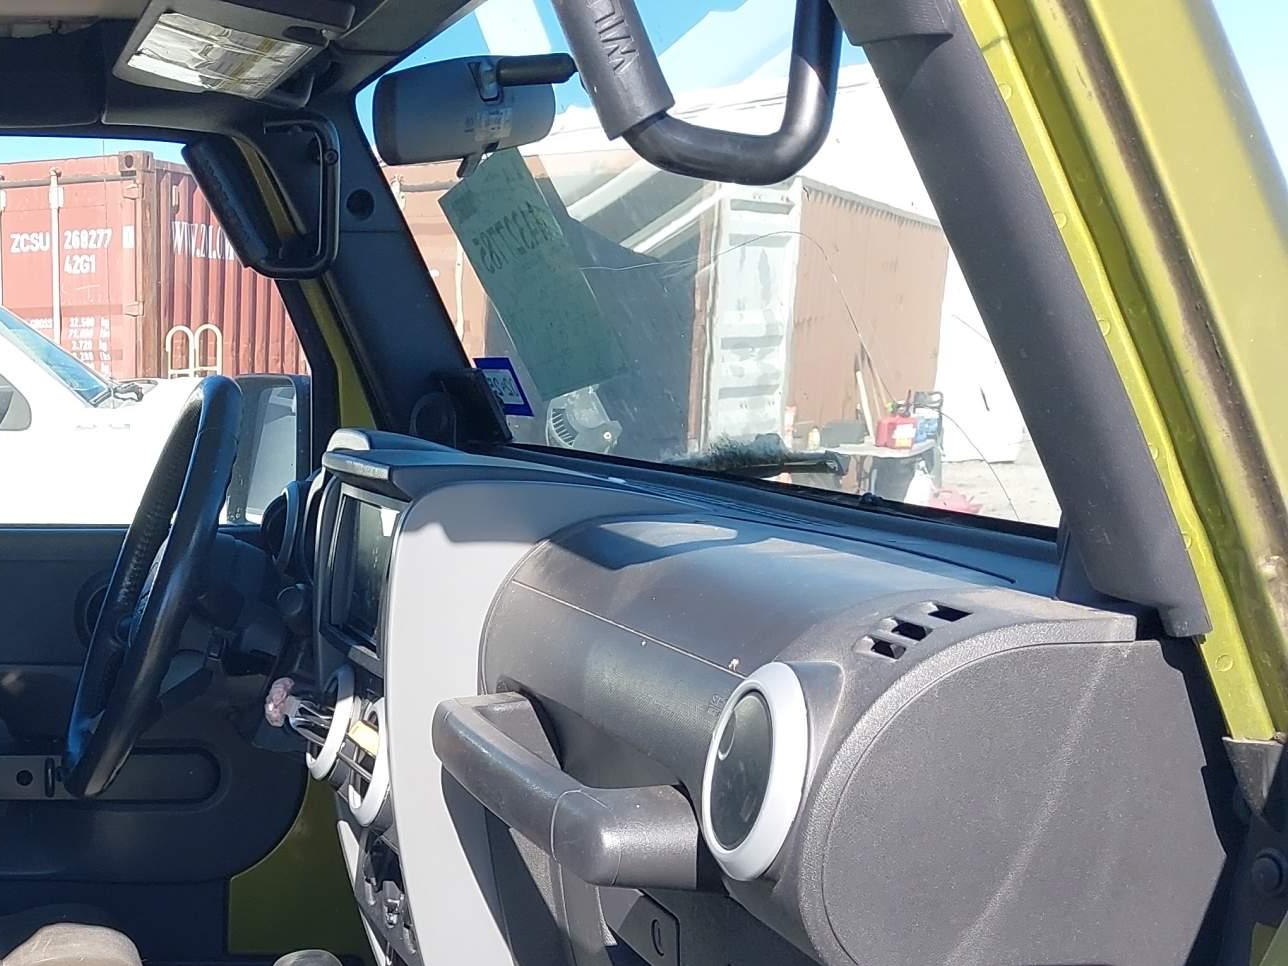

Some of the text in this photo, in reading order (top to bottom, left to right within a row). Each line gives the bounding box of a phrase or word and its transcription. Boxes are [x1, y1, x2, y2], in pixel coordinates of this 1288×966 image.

[10, 231, 50, 253] ZCSU
[63, 228, 112, 250] 268277
[64, 254, 96, 274] 42G1
